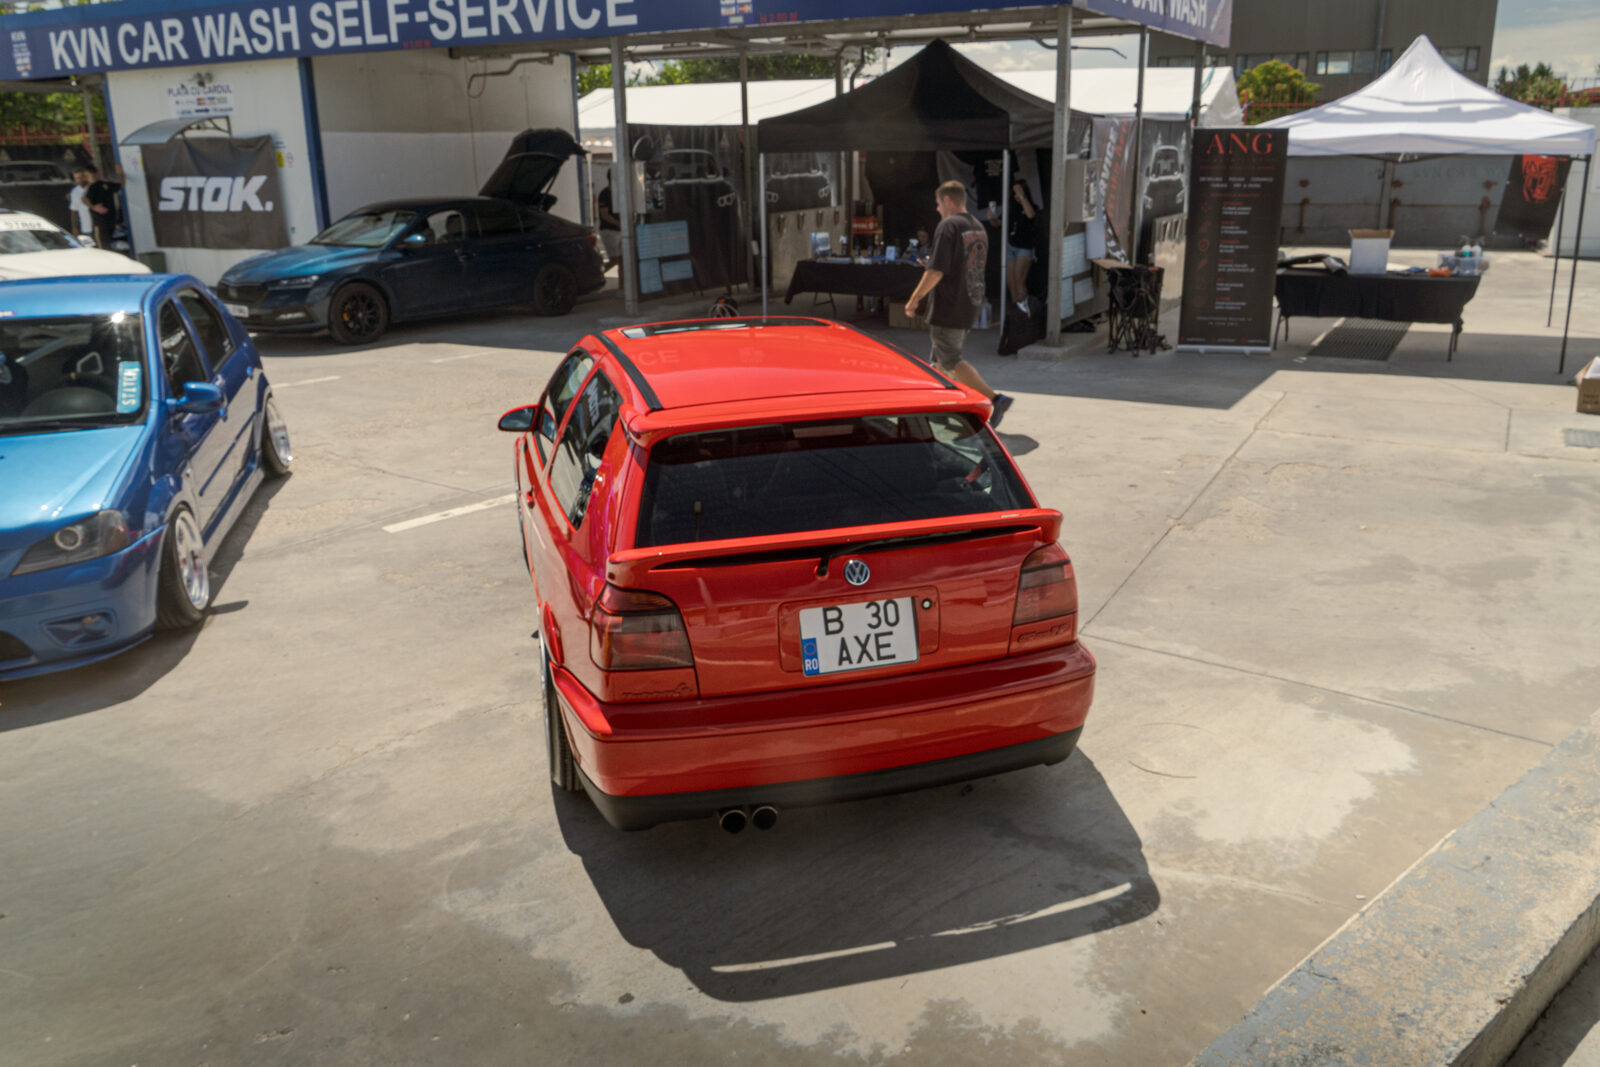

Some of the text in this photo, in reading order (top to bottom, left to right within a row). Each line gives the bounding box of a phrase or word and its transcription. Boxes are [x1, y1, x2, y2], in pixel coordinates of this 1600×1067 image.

[49, 26, 112, 70] KVN
[118, 18, 189, 65] CAR
[192, 6, 300, 58] WASH
[309, 0, 638, 49] SELF-SERVICE
[1205, 132, 1273, 155] ANG
[158, 175, 274, 212] STOK.
[822, 599, 900, 636] B 30
[804, 658, 819, 671] RO
[838, 631, 896, 666] AXE
